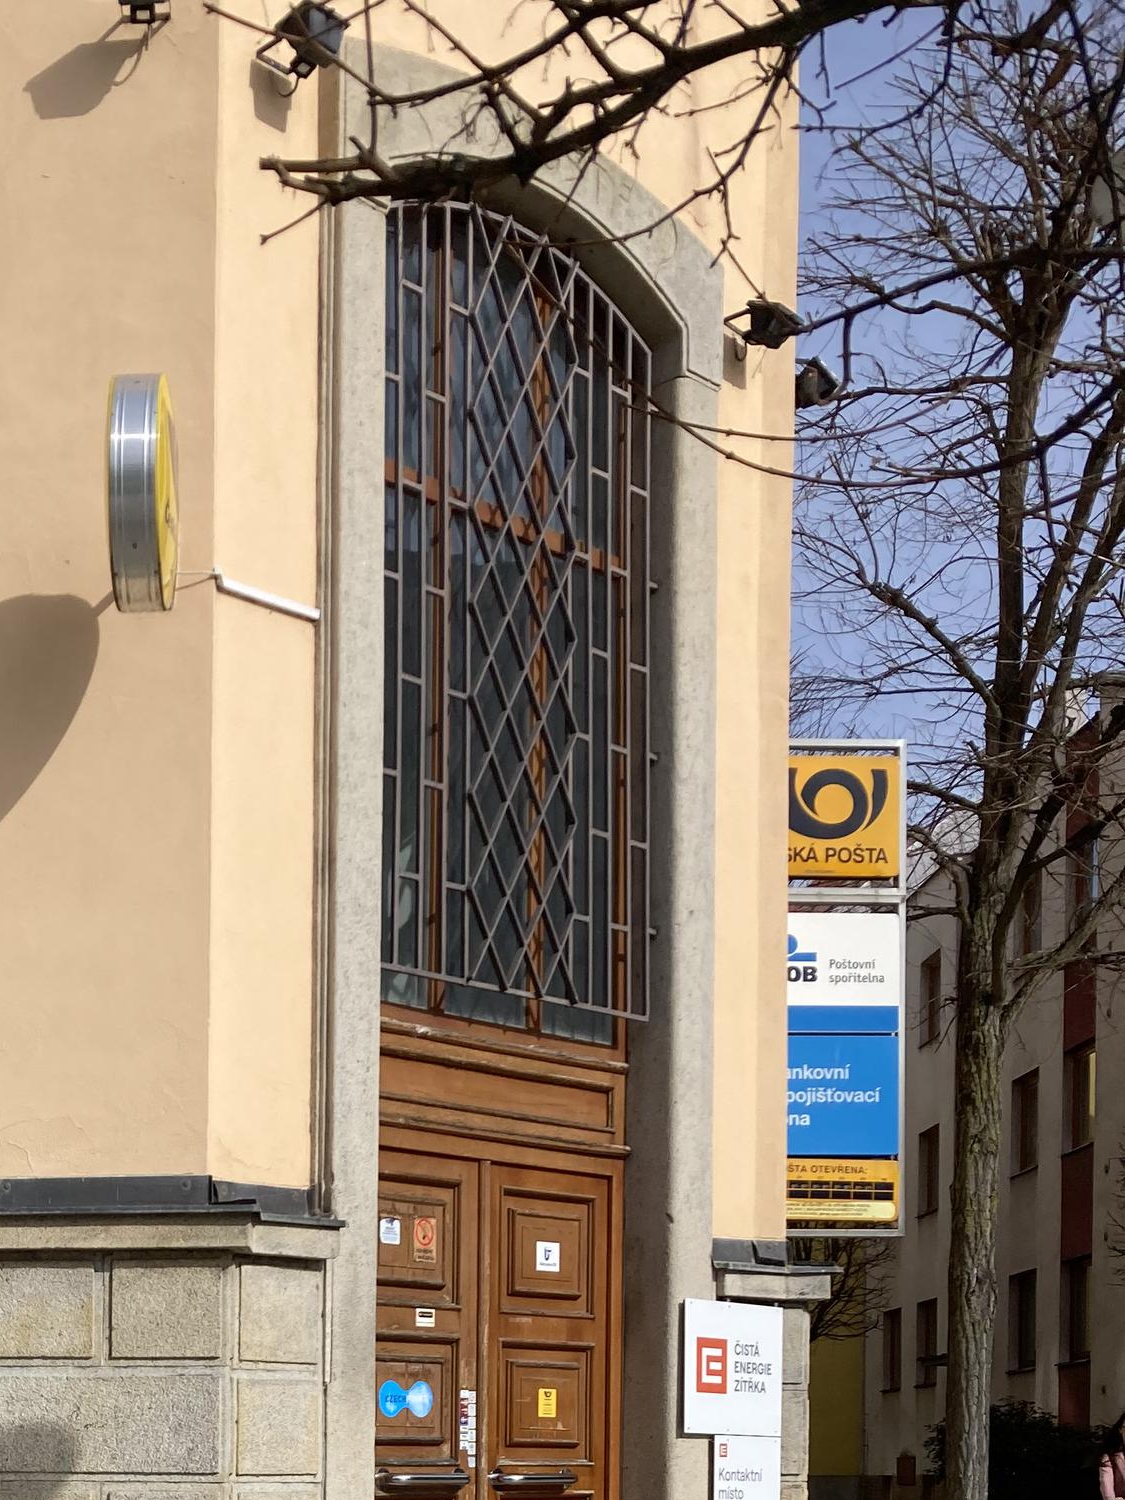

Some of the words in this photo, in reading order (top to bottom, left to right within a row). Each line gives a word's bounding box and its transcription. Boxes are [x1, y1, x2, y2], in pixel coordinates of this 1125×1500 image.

[825, 843, 888, 864] POŠTA
[829, 959, 876, 970] Poštovní
[829, 973, 885, 985] spořitelna
[734, 1340, 760, 1357] ČISTÁ
[734, 1361, 772, 1376] ENERGIE
[734, 1376, 766, 1393] ZÍTŘKA
[385, 1394, 407, 1403] CZECH
[718, 1467, 763, 1482] Kontaktní
[718, 1486, 744, 1500] místo
